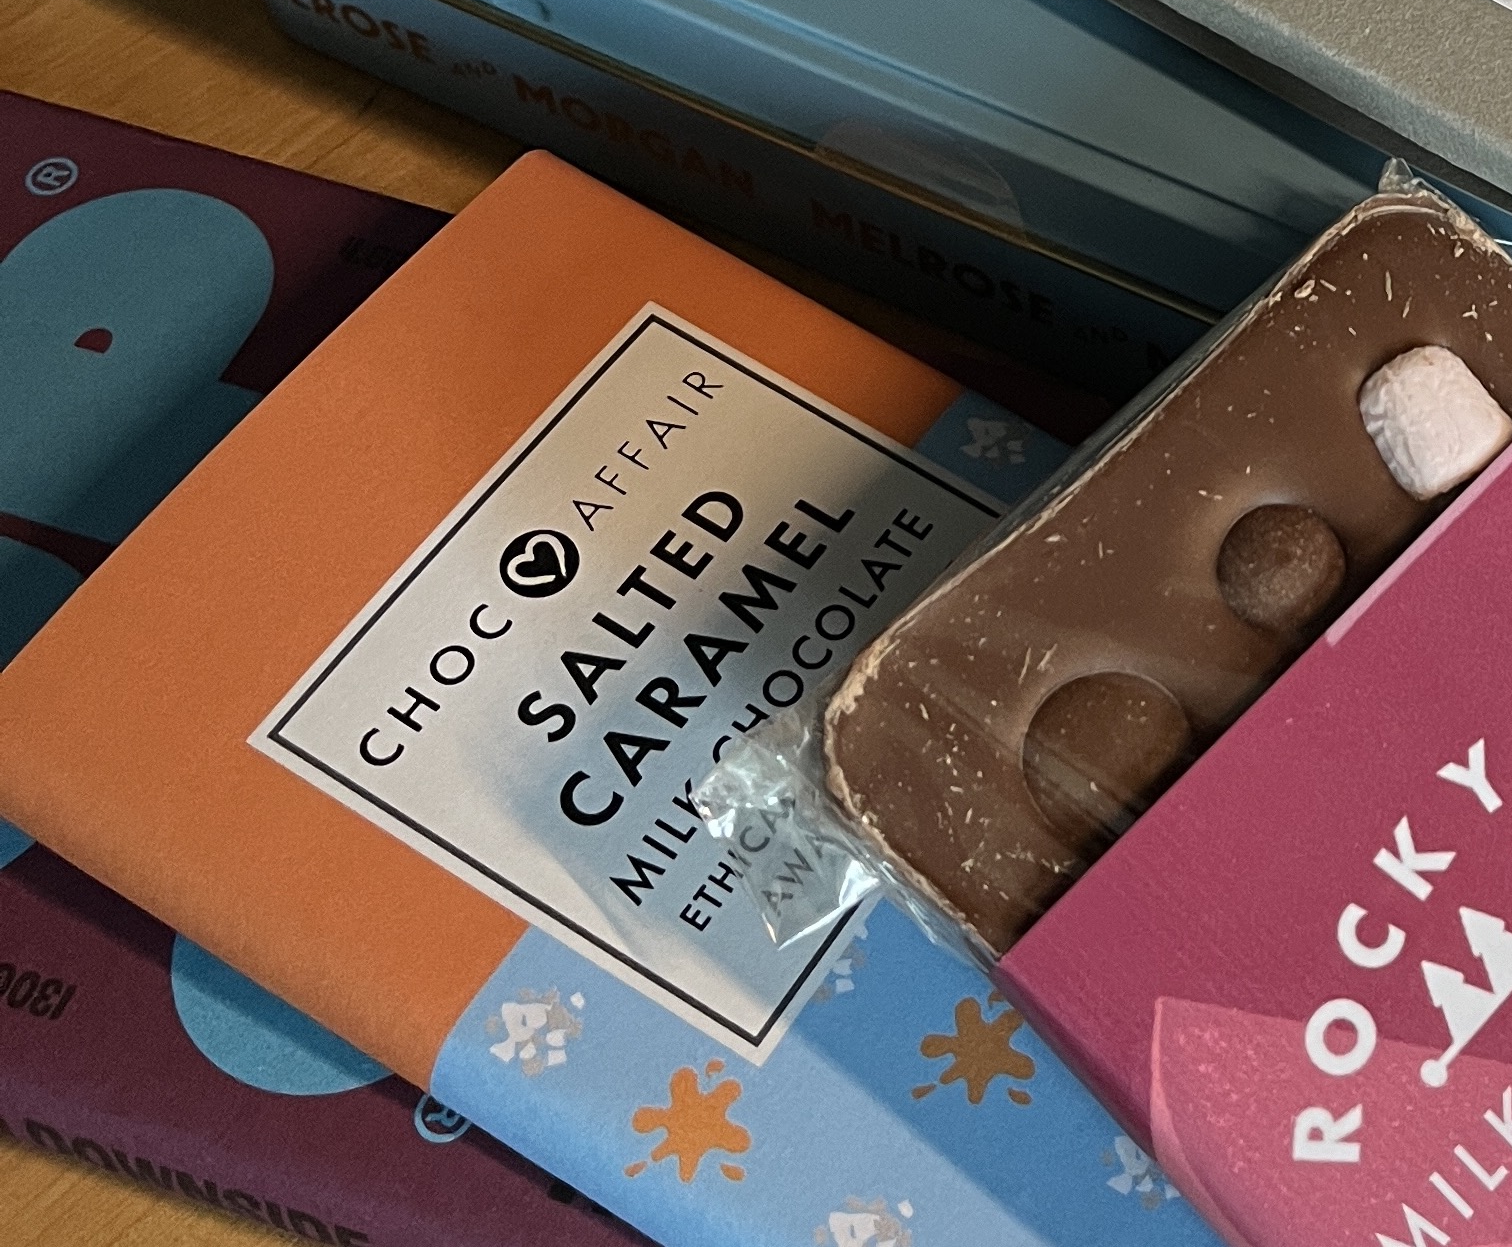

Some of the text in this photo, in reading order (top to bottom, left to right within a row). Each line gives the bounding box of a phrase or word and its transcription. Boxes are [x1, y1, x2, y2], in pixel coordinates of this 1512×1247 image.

[512, 72, 758, 199] MORGAN
[809, 197, 1054, 329] MELROSE
[358, 370, 725, 768] CHOC AFFAIR
[517, 490, 745, 743] SALTED
[560, 499, 856, 826] CARAMEL
[609, 778, 696, 907] MILK
[679, 799, 801, 932] ETHICA
[1292, 737, 1503, 1162] ROCKY
